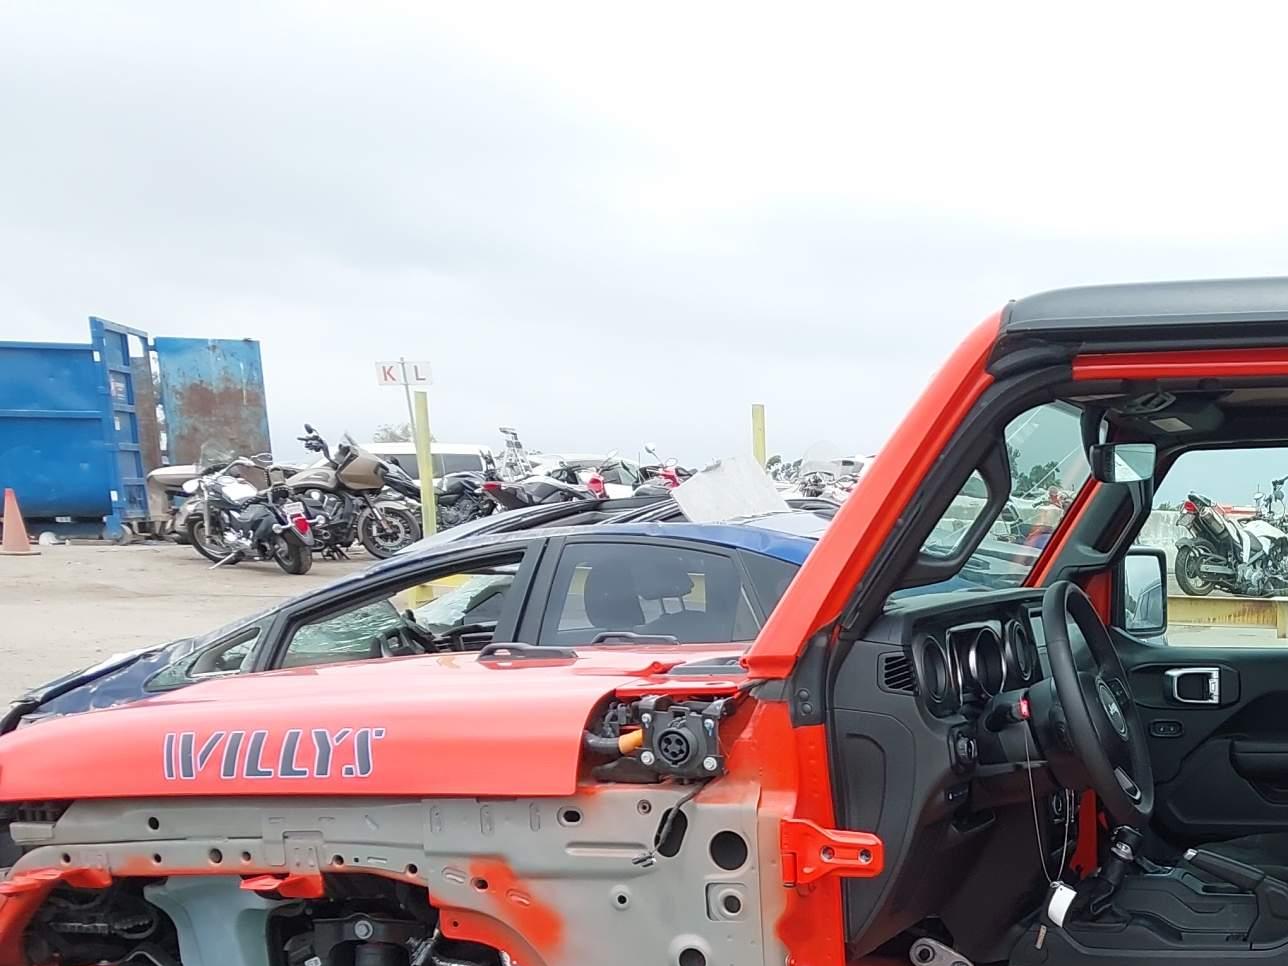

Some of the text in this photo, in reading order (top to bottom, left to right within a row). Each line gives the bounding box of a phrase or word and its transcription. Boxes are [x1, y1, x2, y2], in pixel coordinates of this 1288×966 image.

[382, 365, 396, 381] K
[414, 365, 426, 381] L
[163, 728, 385, 780] WILLYS
